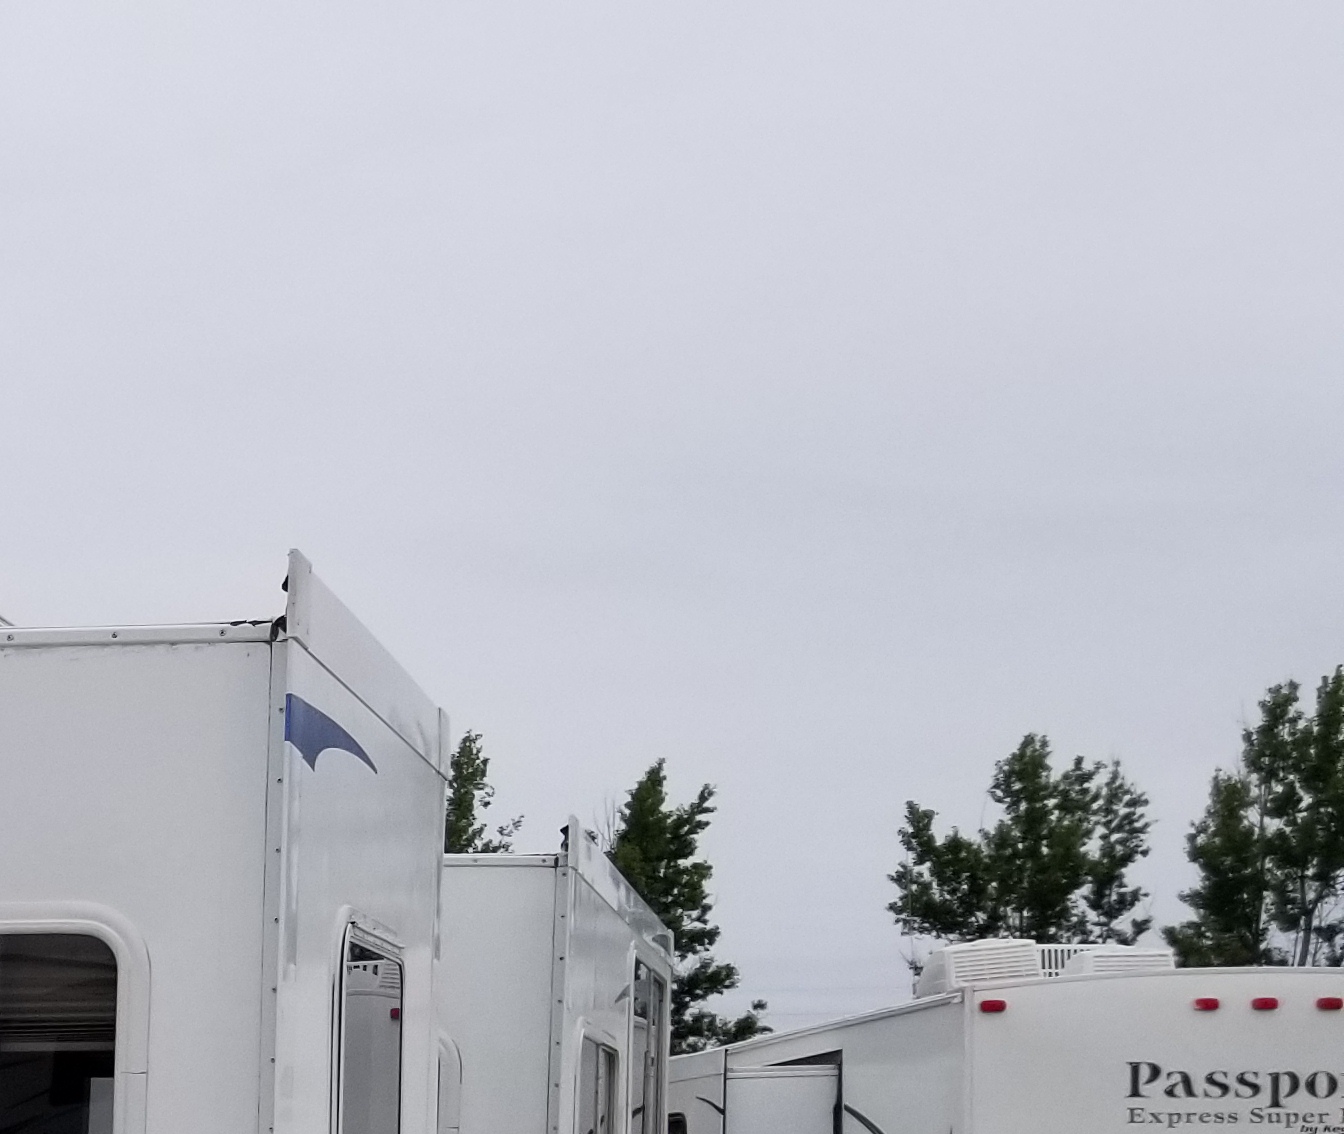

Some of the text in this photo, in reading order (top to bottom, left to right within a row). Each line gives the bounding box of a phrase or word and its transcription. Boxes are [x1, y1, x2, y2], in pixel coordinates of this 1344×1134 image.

[1125, 1061, 1344, 1109] Passpo
[1127, 1107, 1239, 1129] Express
[1250, 1107, 1330, 1129] Super
